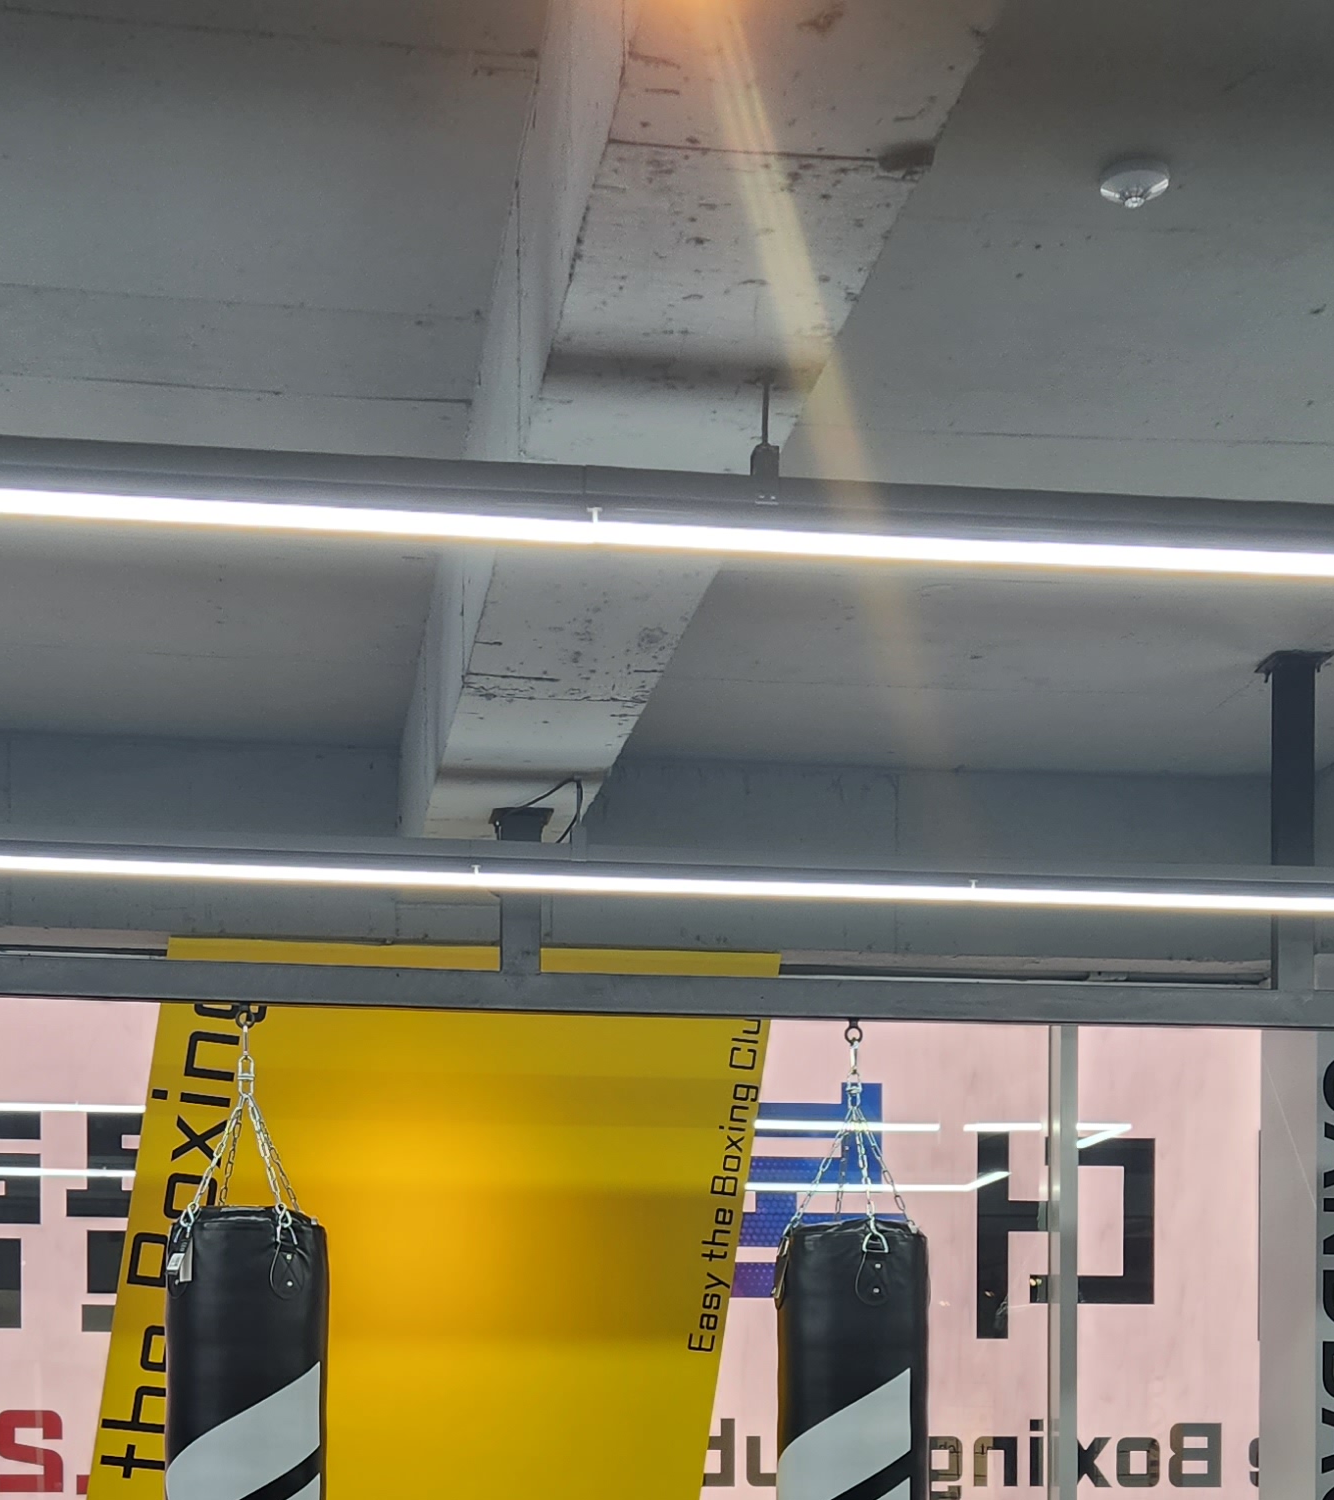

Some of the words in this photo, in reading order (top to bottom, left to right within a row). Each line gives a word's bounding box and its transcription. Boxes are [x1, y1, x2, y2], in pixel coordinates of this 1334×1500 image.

[729, 1018, 761, 1070] Clu
[710, 1083, 759, 1197] Boxing
[701, 1207, 734, 1262] the
[688, 1271, 731, 1353] Easy
